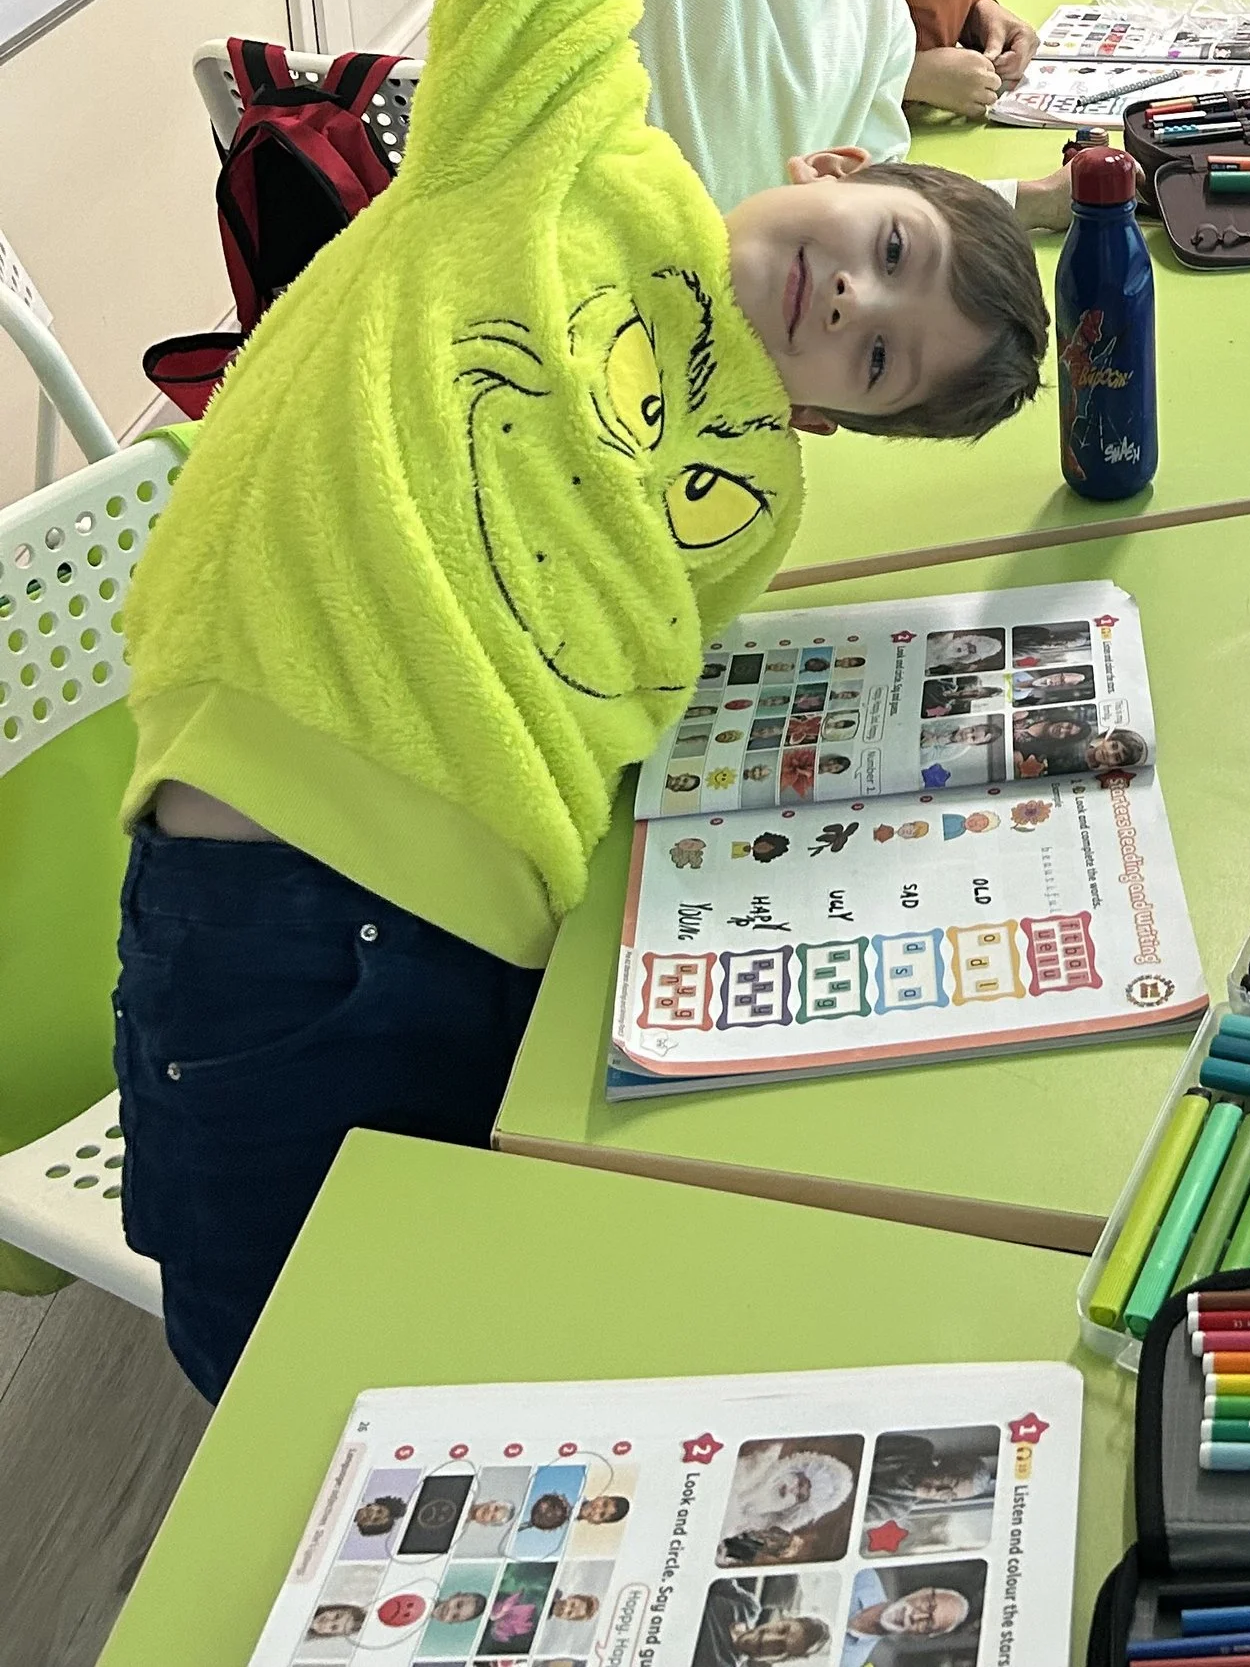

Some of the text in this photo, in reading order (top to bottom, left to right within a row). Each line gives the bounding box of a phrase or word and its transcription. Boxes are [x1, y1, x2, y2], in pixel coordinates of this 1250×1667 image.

[866, 750, 877, 784] Number
[1074, 796, 1086, 814] Look
[1078, 815, 1090, 831] and
[1079, 830, 1095, 868] complete
[1086, 868, 1098, 882] the
[1107, 777, 1161, 964] Starters Reading and Writing
[900, 883, 919, 909] SAD
[972, 878, 992, 905] OLD
[677, 902, 713, 941] YOUNG
[1018, 1424, 1037, 1436] 1
[692, 1444, 711, 1456] 2
[679, 1472, 701, 1506] Look
[1011, 1484, 1030, 1526] Listen
[672, 1509, 691, 1536] and
[1008, 1528, 1024, 1556] and
[661, 1539, 683, 1583] circle.
[1004, 1558, 1022, 1601] colour
[615, 1589, 642, 1636] Happy.
[650, 1586, 674, 1612] Say
[1001, 1603, 1018, 1628] the
[645, 1615, 664, 1645] and
